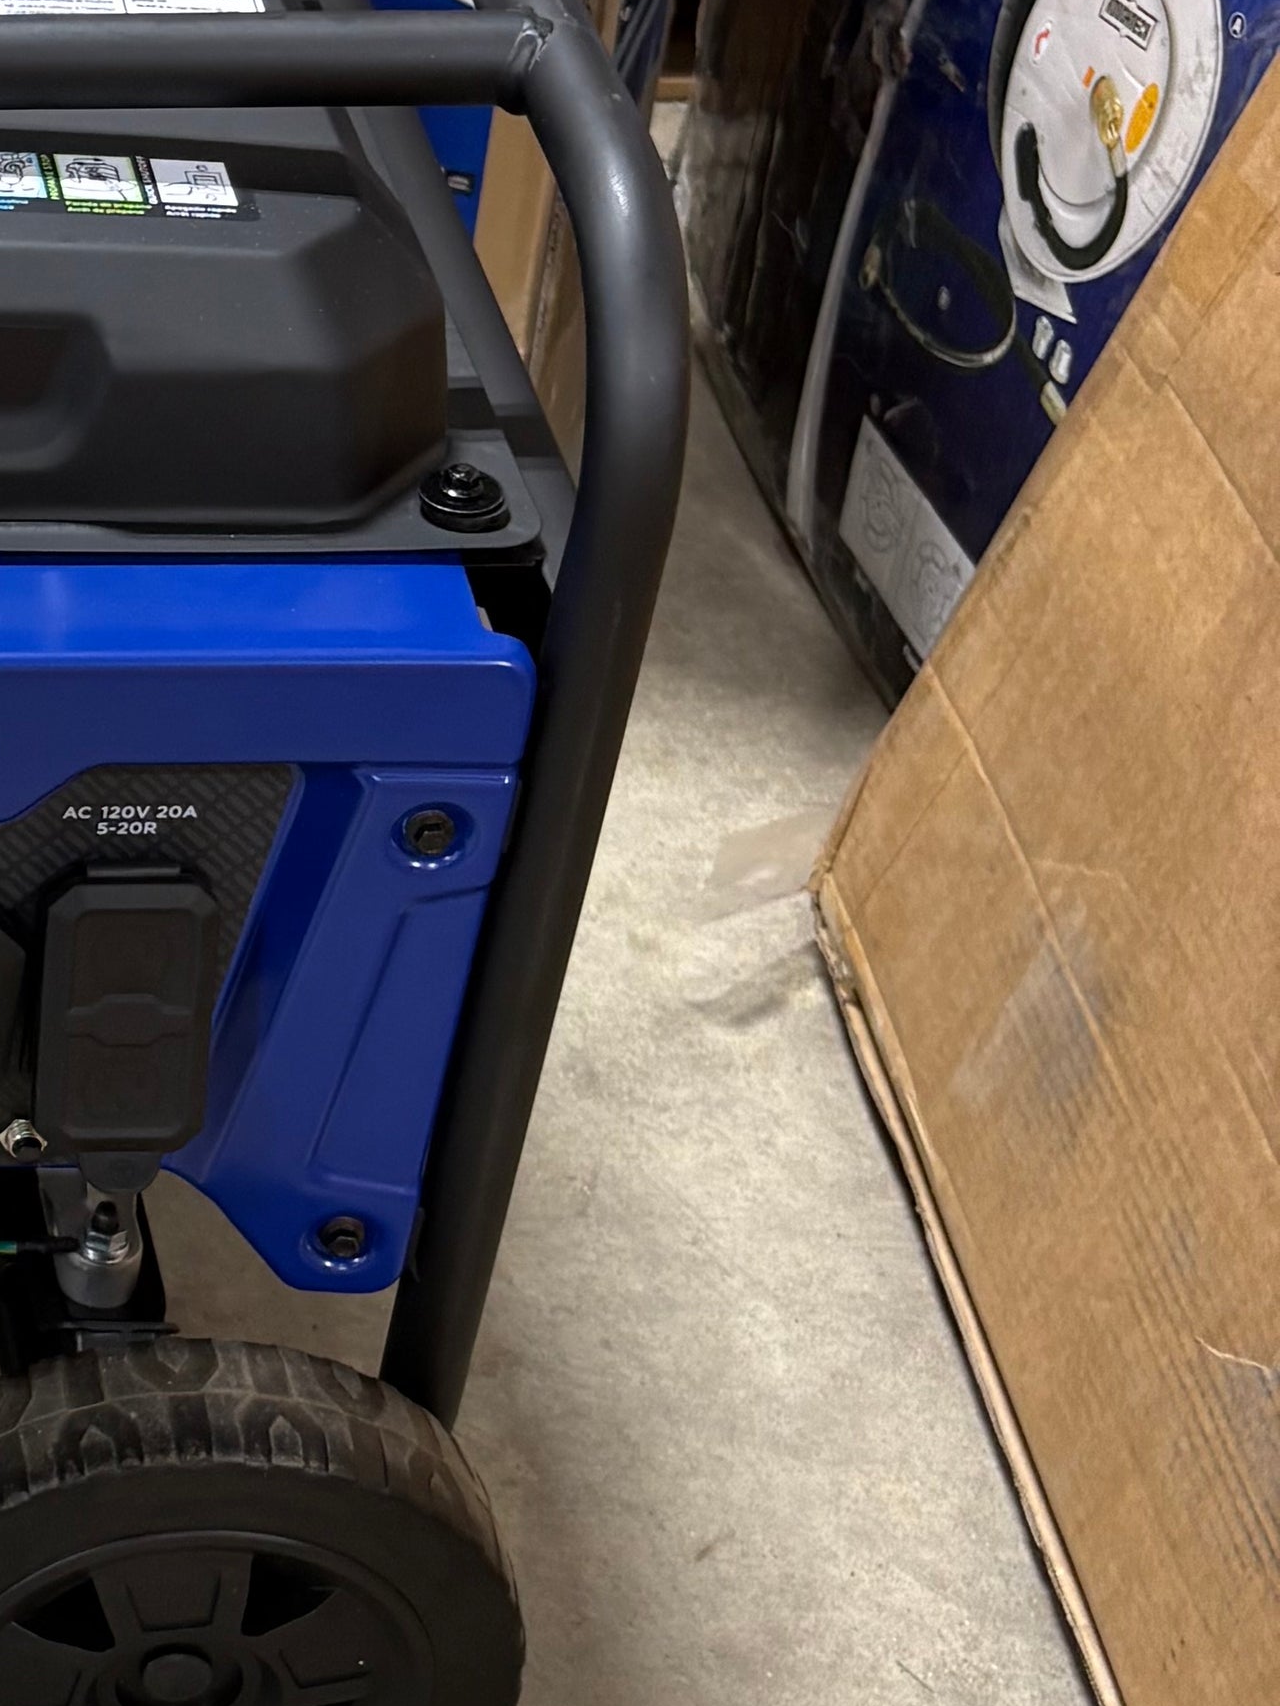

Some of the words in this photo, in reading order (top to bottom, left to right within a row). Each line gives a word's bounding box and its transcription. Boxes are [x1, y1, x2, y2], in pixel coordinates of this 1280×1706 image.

[63, 805, 92, 820] AC
[99, 805, 149, 820] 120V
[156, 804, 198, 819] 20A
[96, 821, 158, 836] 5-20R
